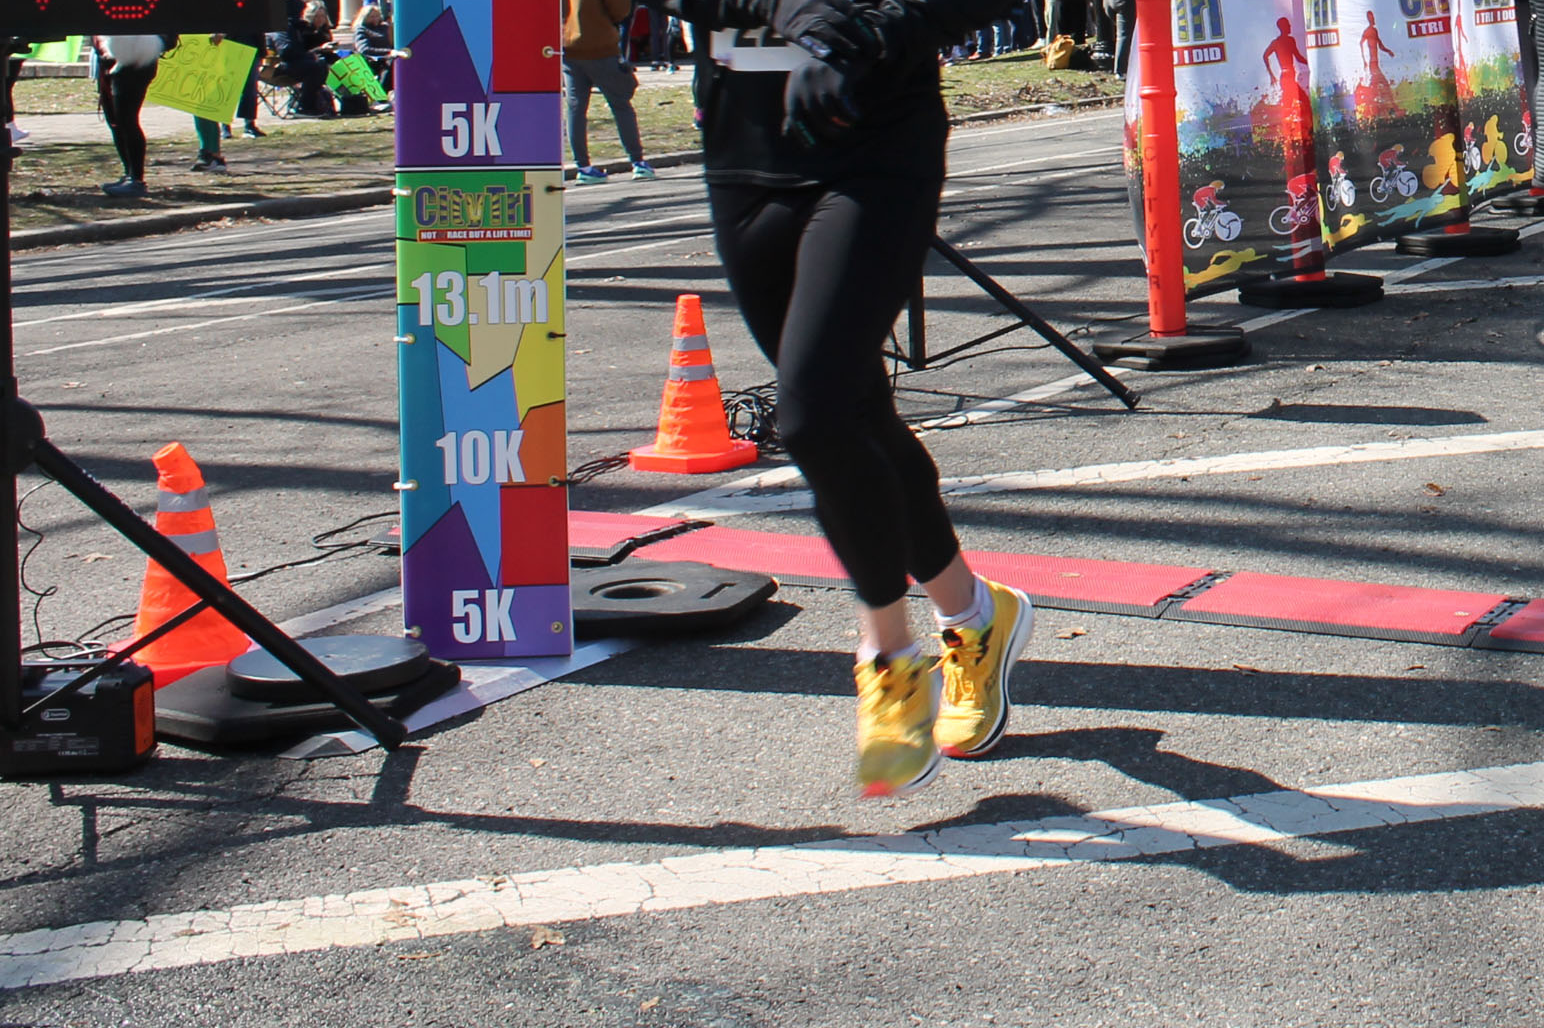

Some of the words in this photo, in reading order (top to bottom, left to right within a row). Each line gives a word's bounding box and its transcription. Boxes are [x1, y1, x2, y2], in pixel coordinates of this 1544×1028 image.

[1419, 20, 1445, 34] TRI
[1192, 47, 1222, 62] DID
[441, 101, 504, 158] 5K
[415, 184, 534, 227] CityTri
[421, 231, 437, 240] NOT
[447, 231, 468, 239] RACE
[411, 270, 548, 326] 13.1m
[436, 429, 526, 486] 10K
[451, 587, 517, 644] 5K
